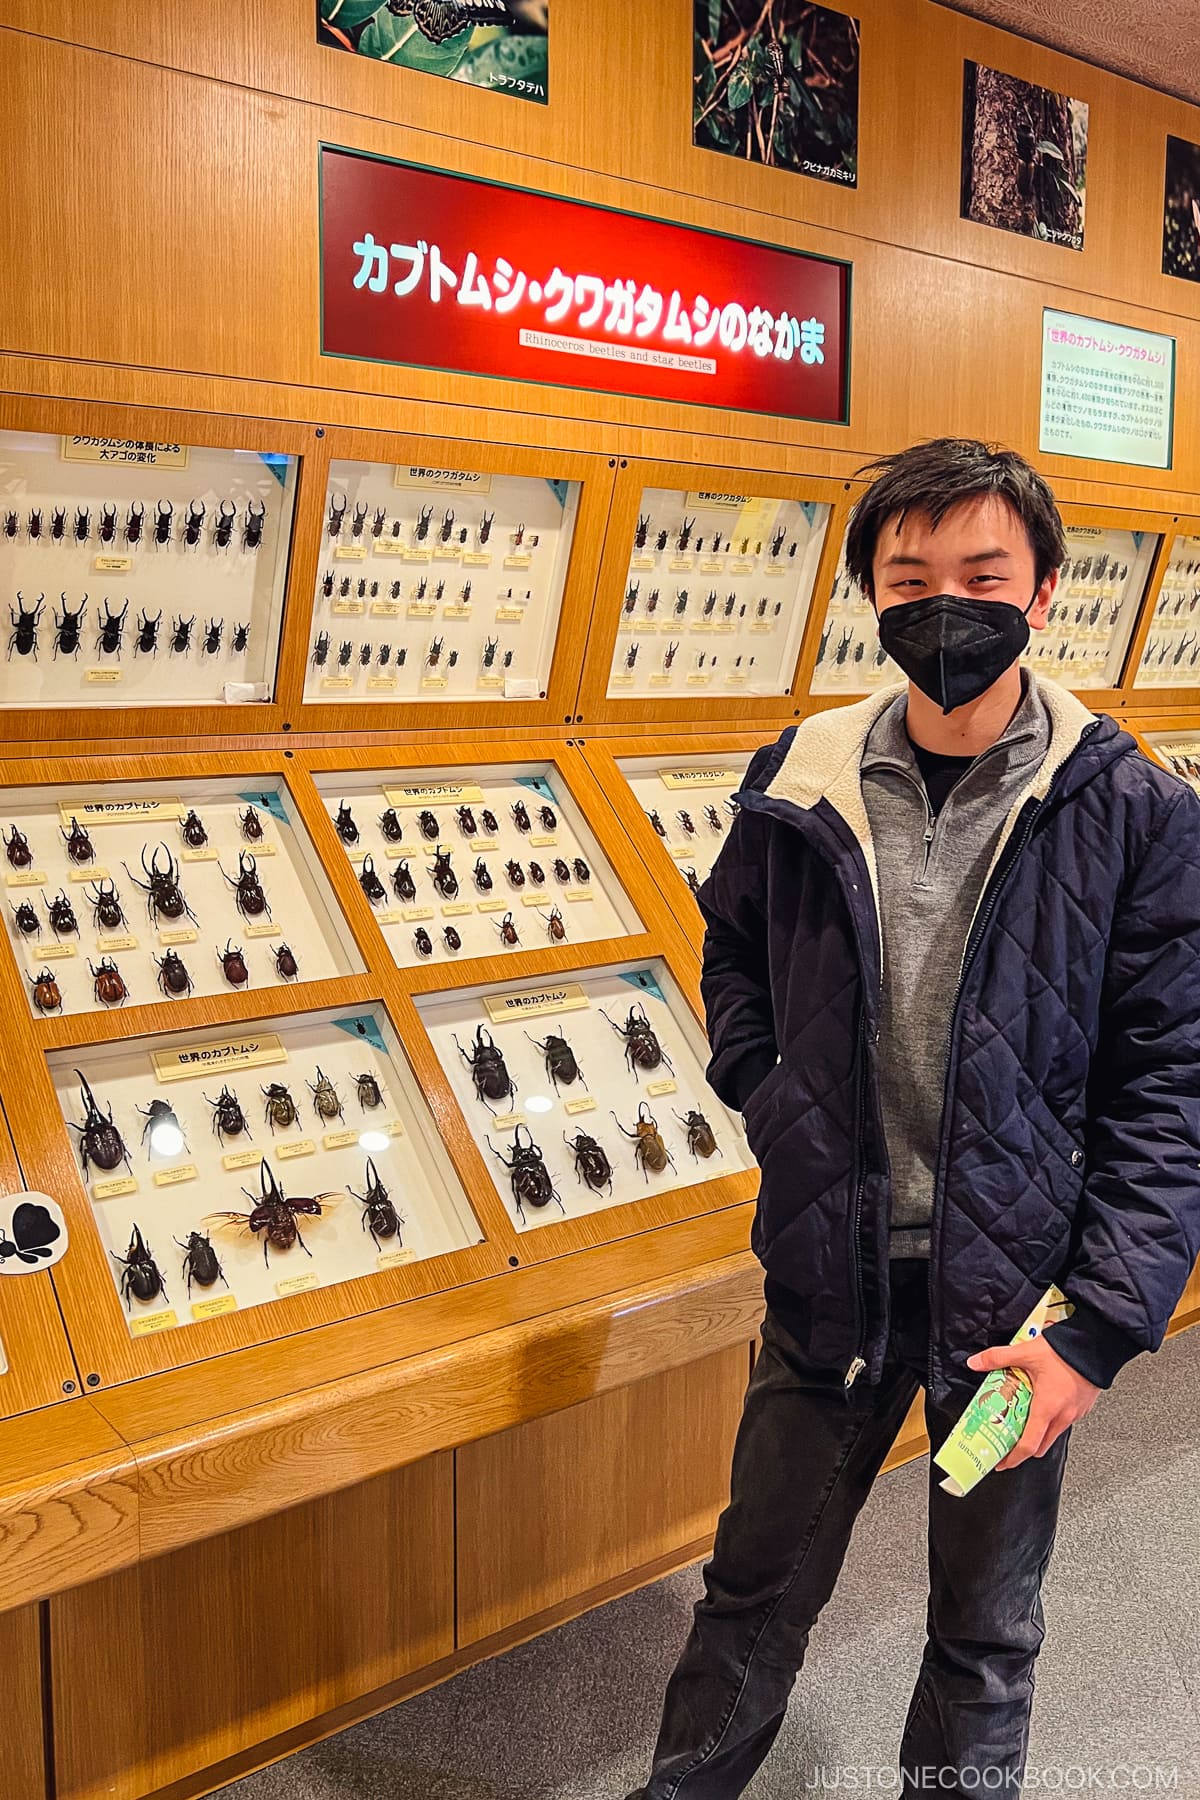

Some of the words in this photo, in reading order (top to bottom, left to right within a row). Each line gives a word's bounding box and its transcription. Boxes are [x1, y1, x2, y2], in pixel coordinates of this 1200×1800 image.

[489, 72, 544, 96] トラフタテハ
[803, 160, 855, 182] クビナガカミキリ
[352, 233, 826, 365] カブトムシ・クワガタムシのなかま
[525, 332, 585, 352] Rhinoceros
[589, 343, 626, 359] beetles
[630, 352, 648, 362] and
[652, 355, 674, 367] stag
[678, 358, 712, 371] beetles
[100, 450, 156, 463] 大アゴの変化
[409, 467, 481, 482] 世界のクワガタムシ
[404, 787, 463, 796] 世界のカブトムシ
[84, 801, 161, 813] 世界のカブトムシ
[505, 991, 566, 1008] 世界のカブトムシ
[178, 1043, 259, 1063] 世界のカブトムシ
